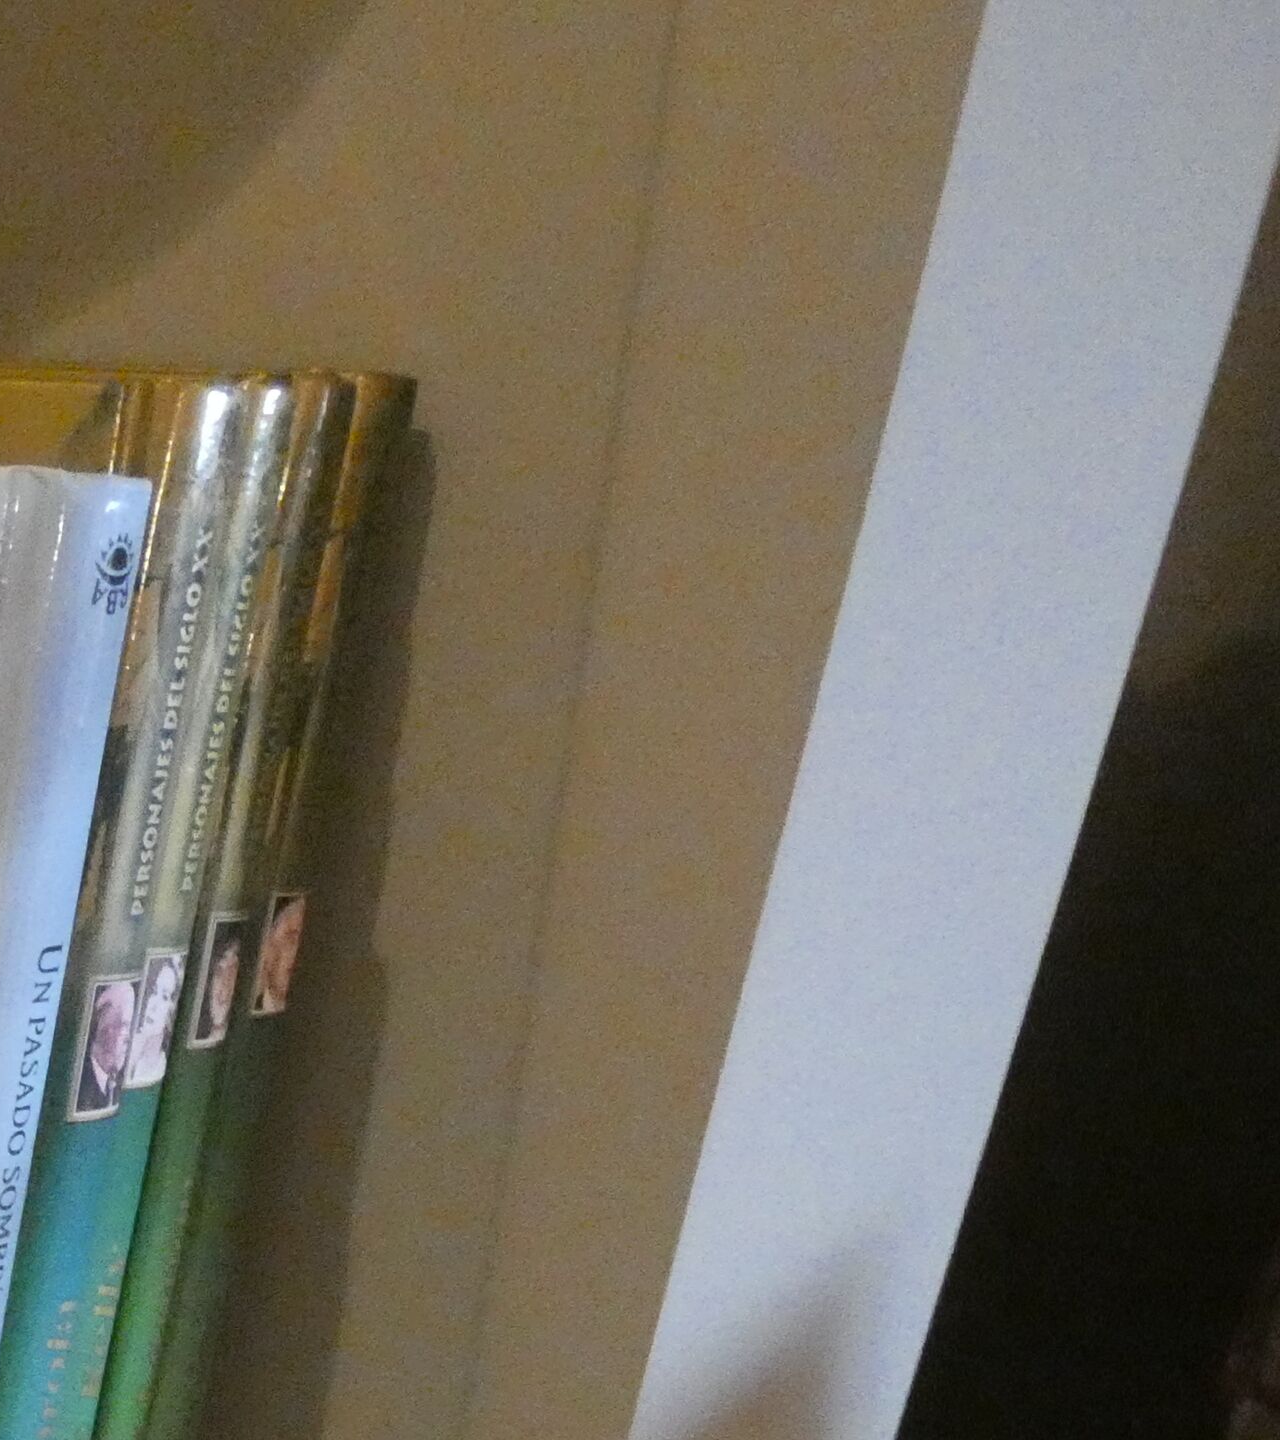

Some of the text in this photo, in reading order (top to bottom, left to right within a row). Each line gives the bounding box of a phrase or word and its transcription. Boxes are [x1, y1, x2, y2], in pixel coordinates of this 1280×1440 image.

[130, 525, 213, 916] PERSONAJES DEL SIGLO XX
[6, 1016, 47, 1158] PASADO
